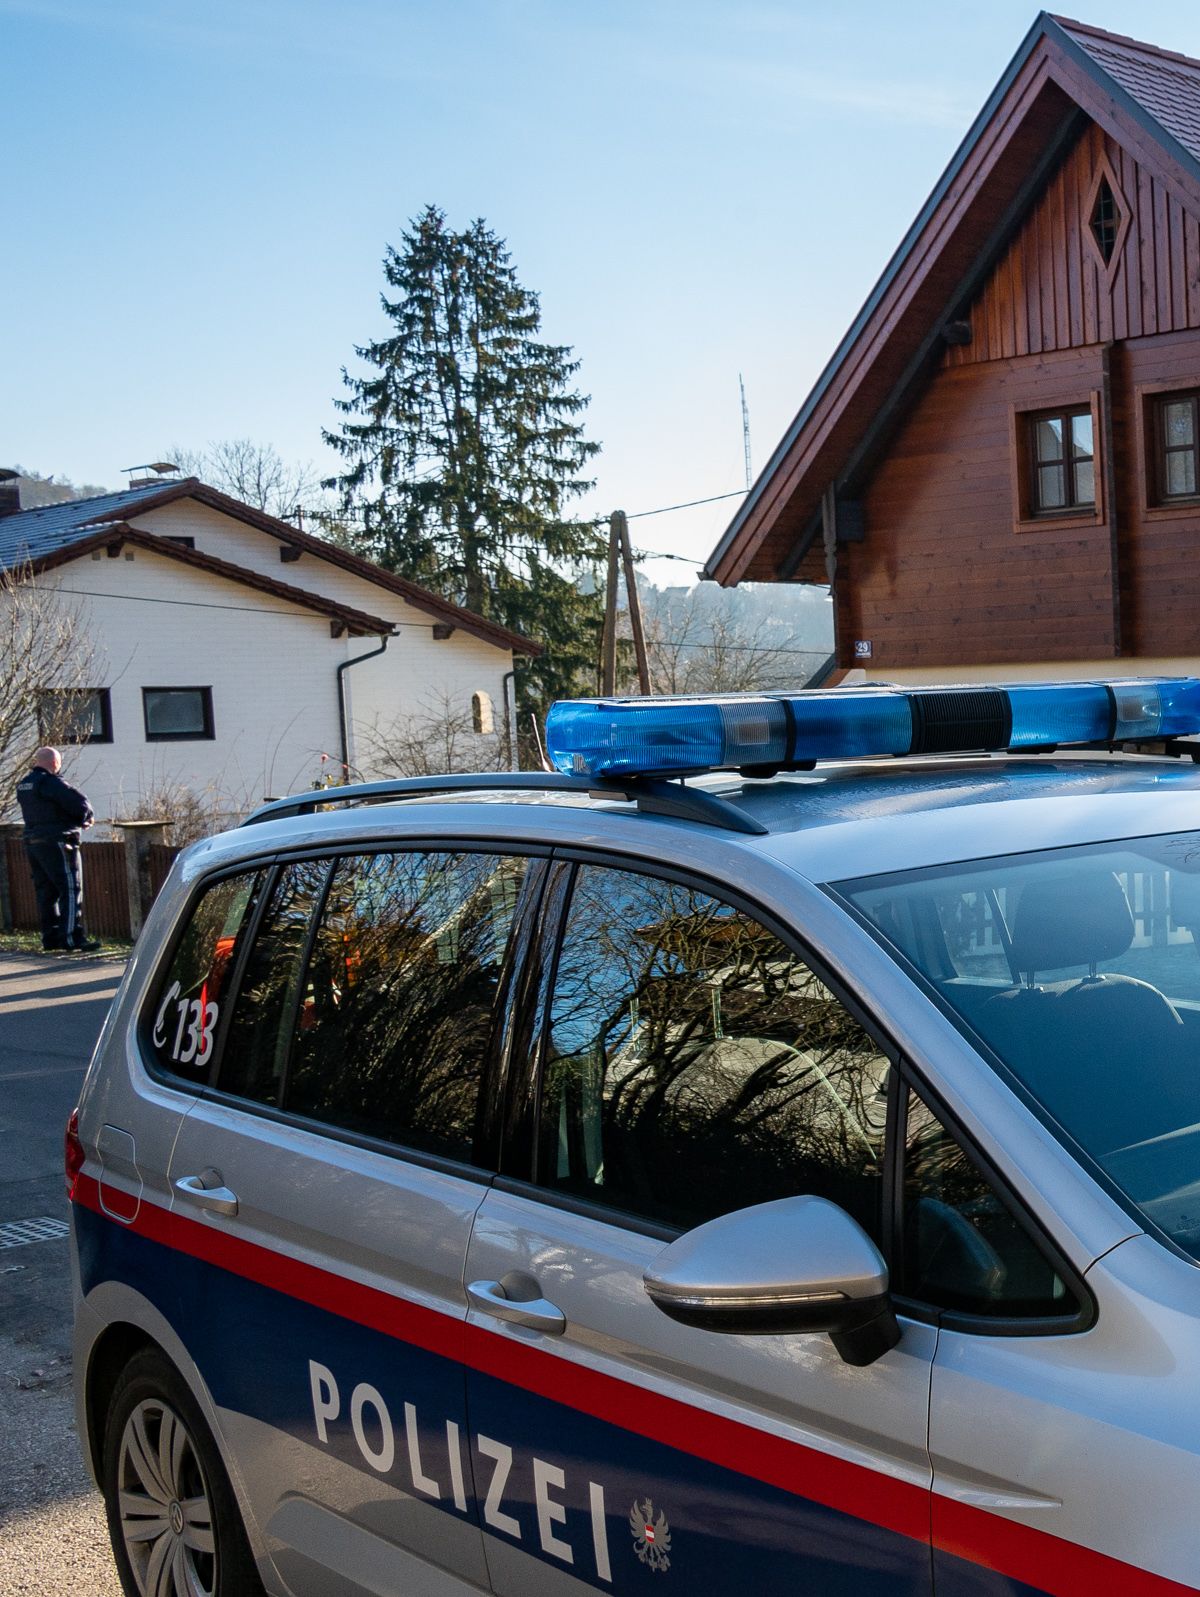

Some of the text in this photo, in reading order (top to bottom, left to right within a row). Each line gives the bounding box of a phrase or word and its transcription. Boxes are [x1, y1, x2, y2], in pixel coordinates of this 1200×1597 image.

[857, 642, 868, 653] 29
[172, 998, 219, 1067] 133
[309, 1359, 613, 1583] POLIZEI
